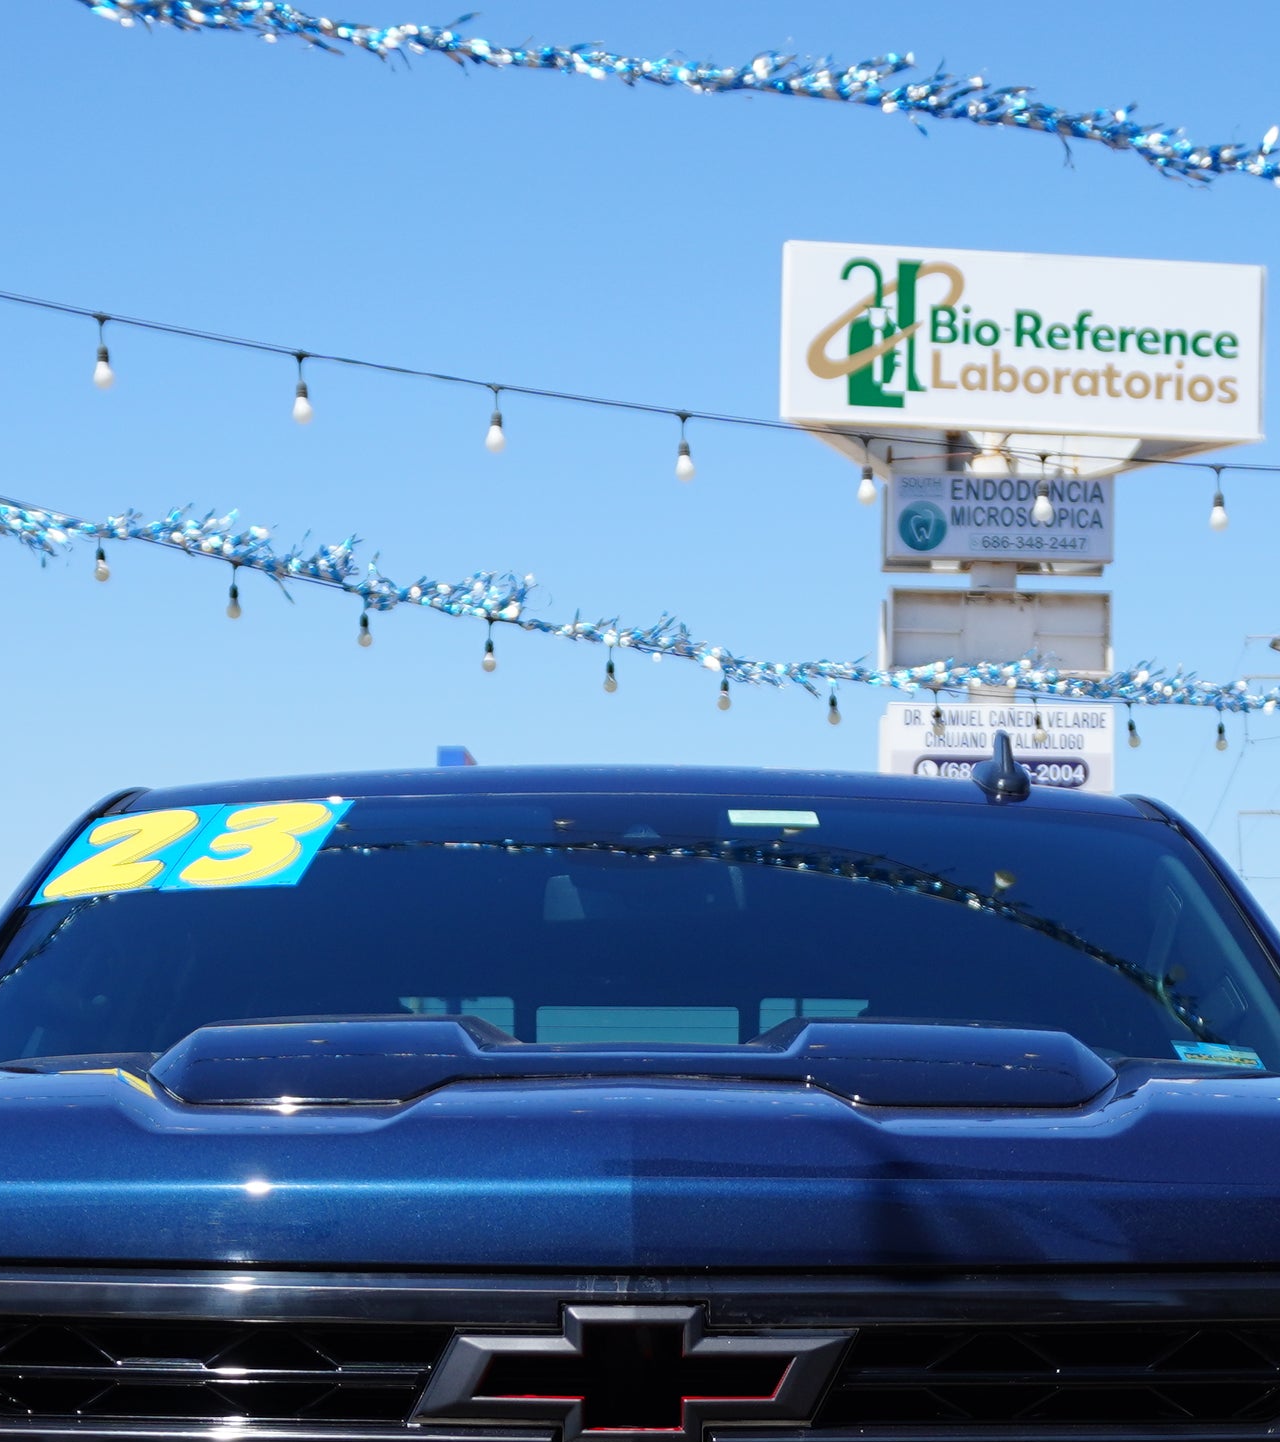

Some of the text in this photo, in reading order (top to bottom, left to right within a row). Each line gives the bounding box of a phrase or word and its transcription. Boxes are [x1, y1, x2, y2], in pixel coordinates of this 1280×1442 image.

[931, 349, 1239, 404] Laboratorios
[982, 535, 1087, 550] 686-348-2447
[904, 709, 925, 726] DR.
[931, 709, 984, 727] AMUEL
[1047, 712, 1107, 729] VELARDE
[43, 802, 334, 900] 23
